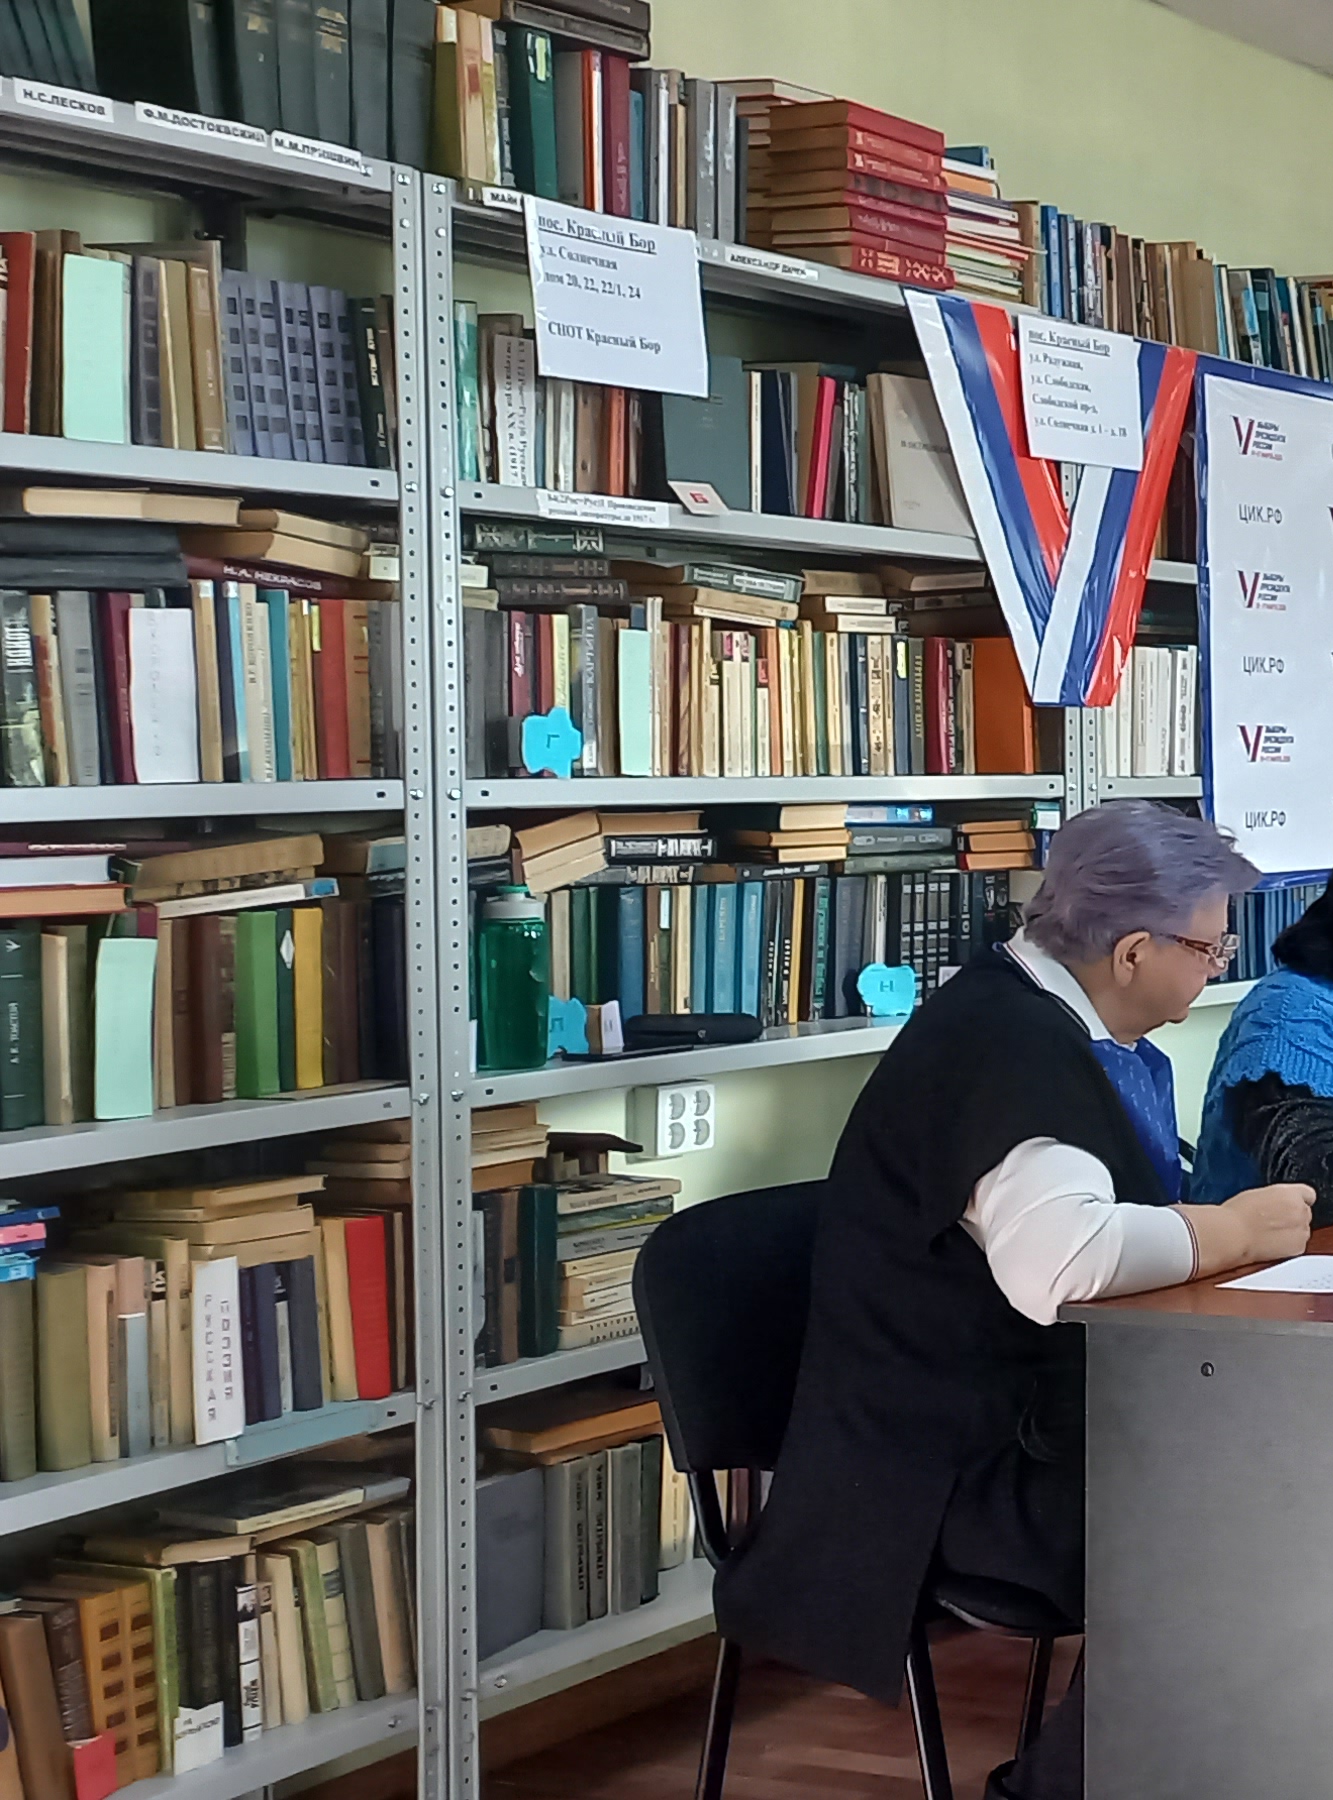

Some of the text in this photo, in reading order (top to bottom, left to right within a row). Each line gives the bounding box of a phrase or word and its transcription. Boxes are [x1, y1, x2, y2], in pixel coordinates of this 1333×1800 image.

[629, 232, 656, 253] Бор
[585, 328, 637, 351] Красный
[639, 337, 661, 355] Бор
[1242, 655, 1285, 676] ЦИК.РФ
[1244, 810, 1287, 830] ЦИК.РФ
